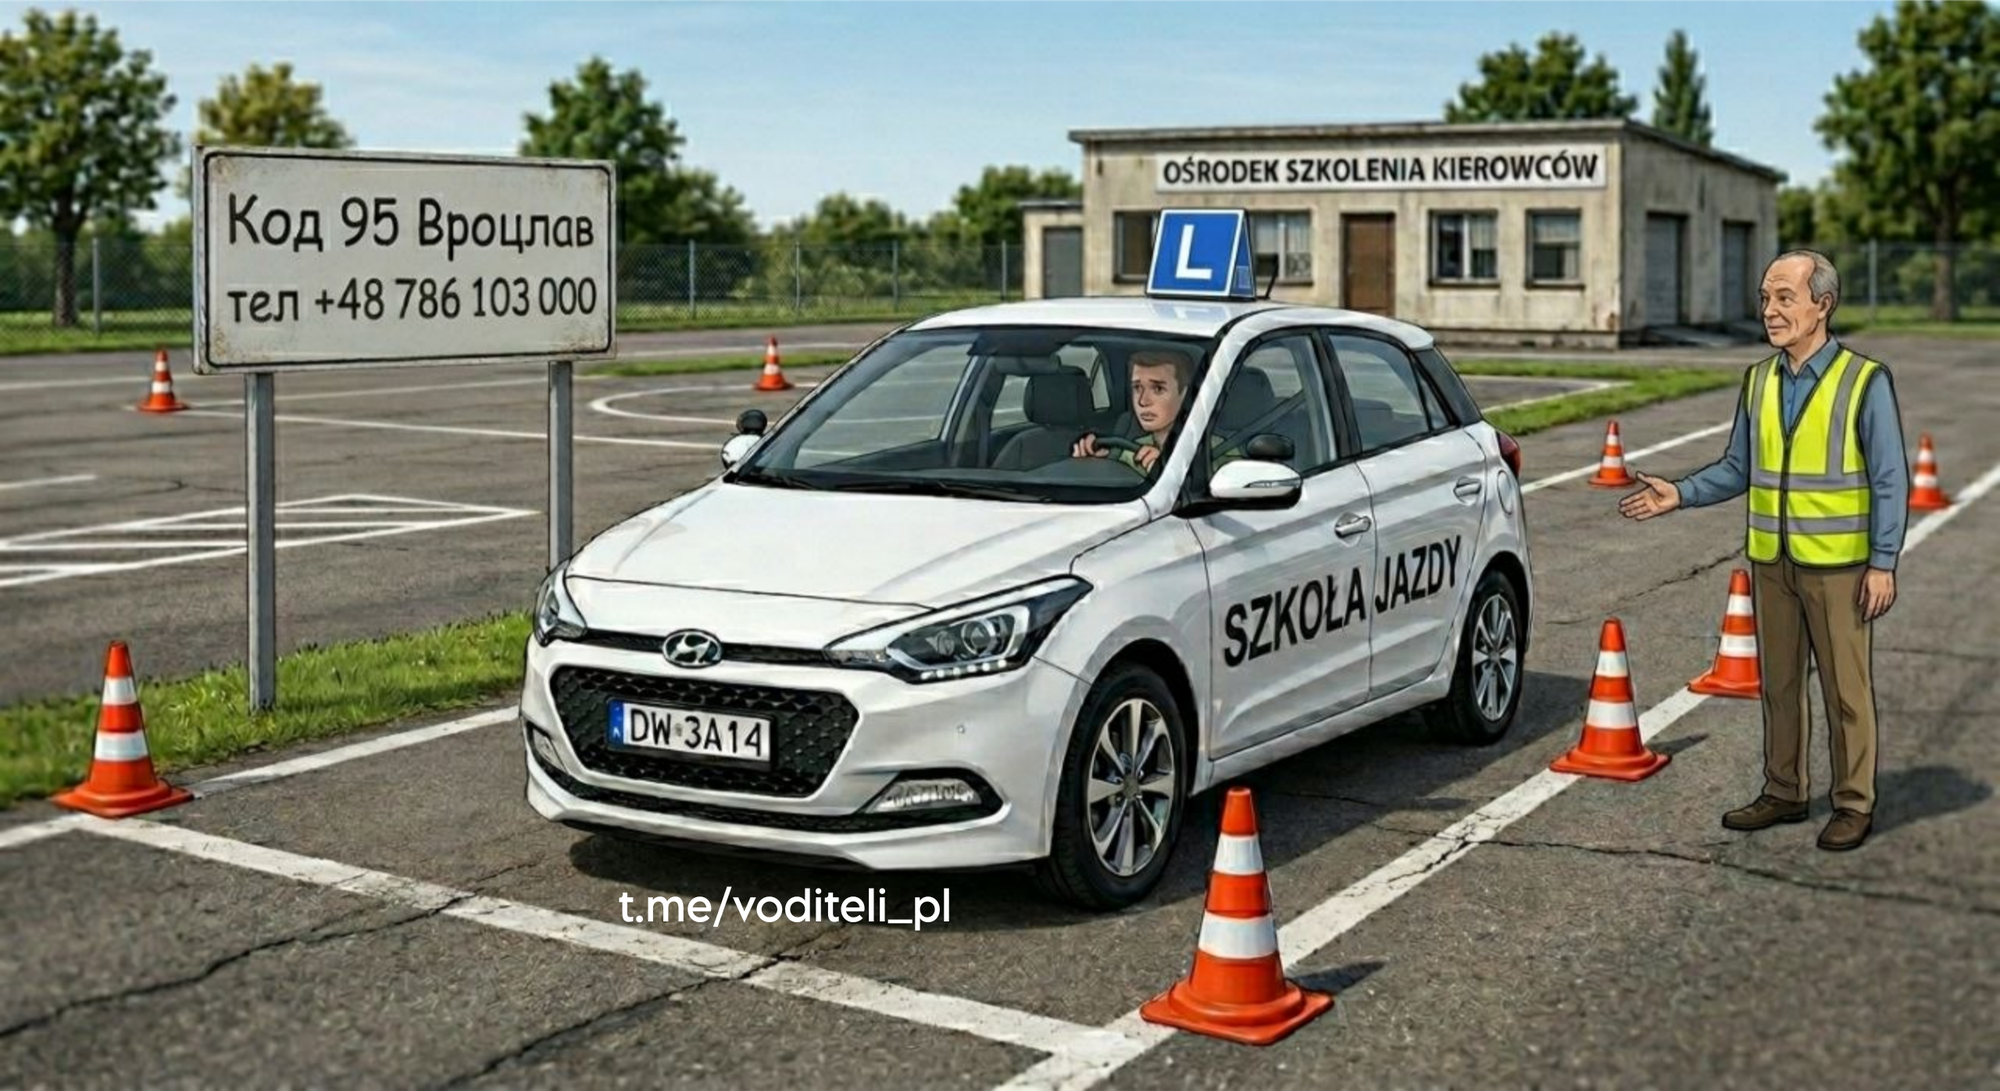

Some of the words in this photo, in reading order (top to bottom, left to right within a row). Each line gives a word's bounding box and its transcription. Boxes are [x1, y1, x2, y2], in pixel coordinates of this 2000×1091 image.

[1163, 155, 1279, 184] OŚRODEK
[1286, 157, 1426, 183] SZKOLENIA
[1432, 150, 1598, 181] KIEROWCÓW
[229, 193, 323, 252] Код
[341, 197, 399, 247] 95
[418, 198, 595, 261] Вроцлав
[1175, 224, 1213, 279] L
[227, 290, 300, 323] тел
[315, 278, 385, 320] +48
[395, 277, 461, 319] 786
[472, 277, 530, 316] 103
[539, 277, 597, 316] 000
[1224, 567, 1367, 667] SZKOŁA
[1375, 535, 1461, 613] JAZDY
[630, 708, 671, 745] DW
[685, 716, 761, 757] 3A14
